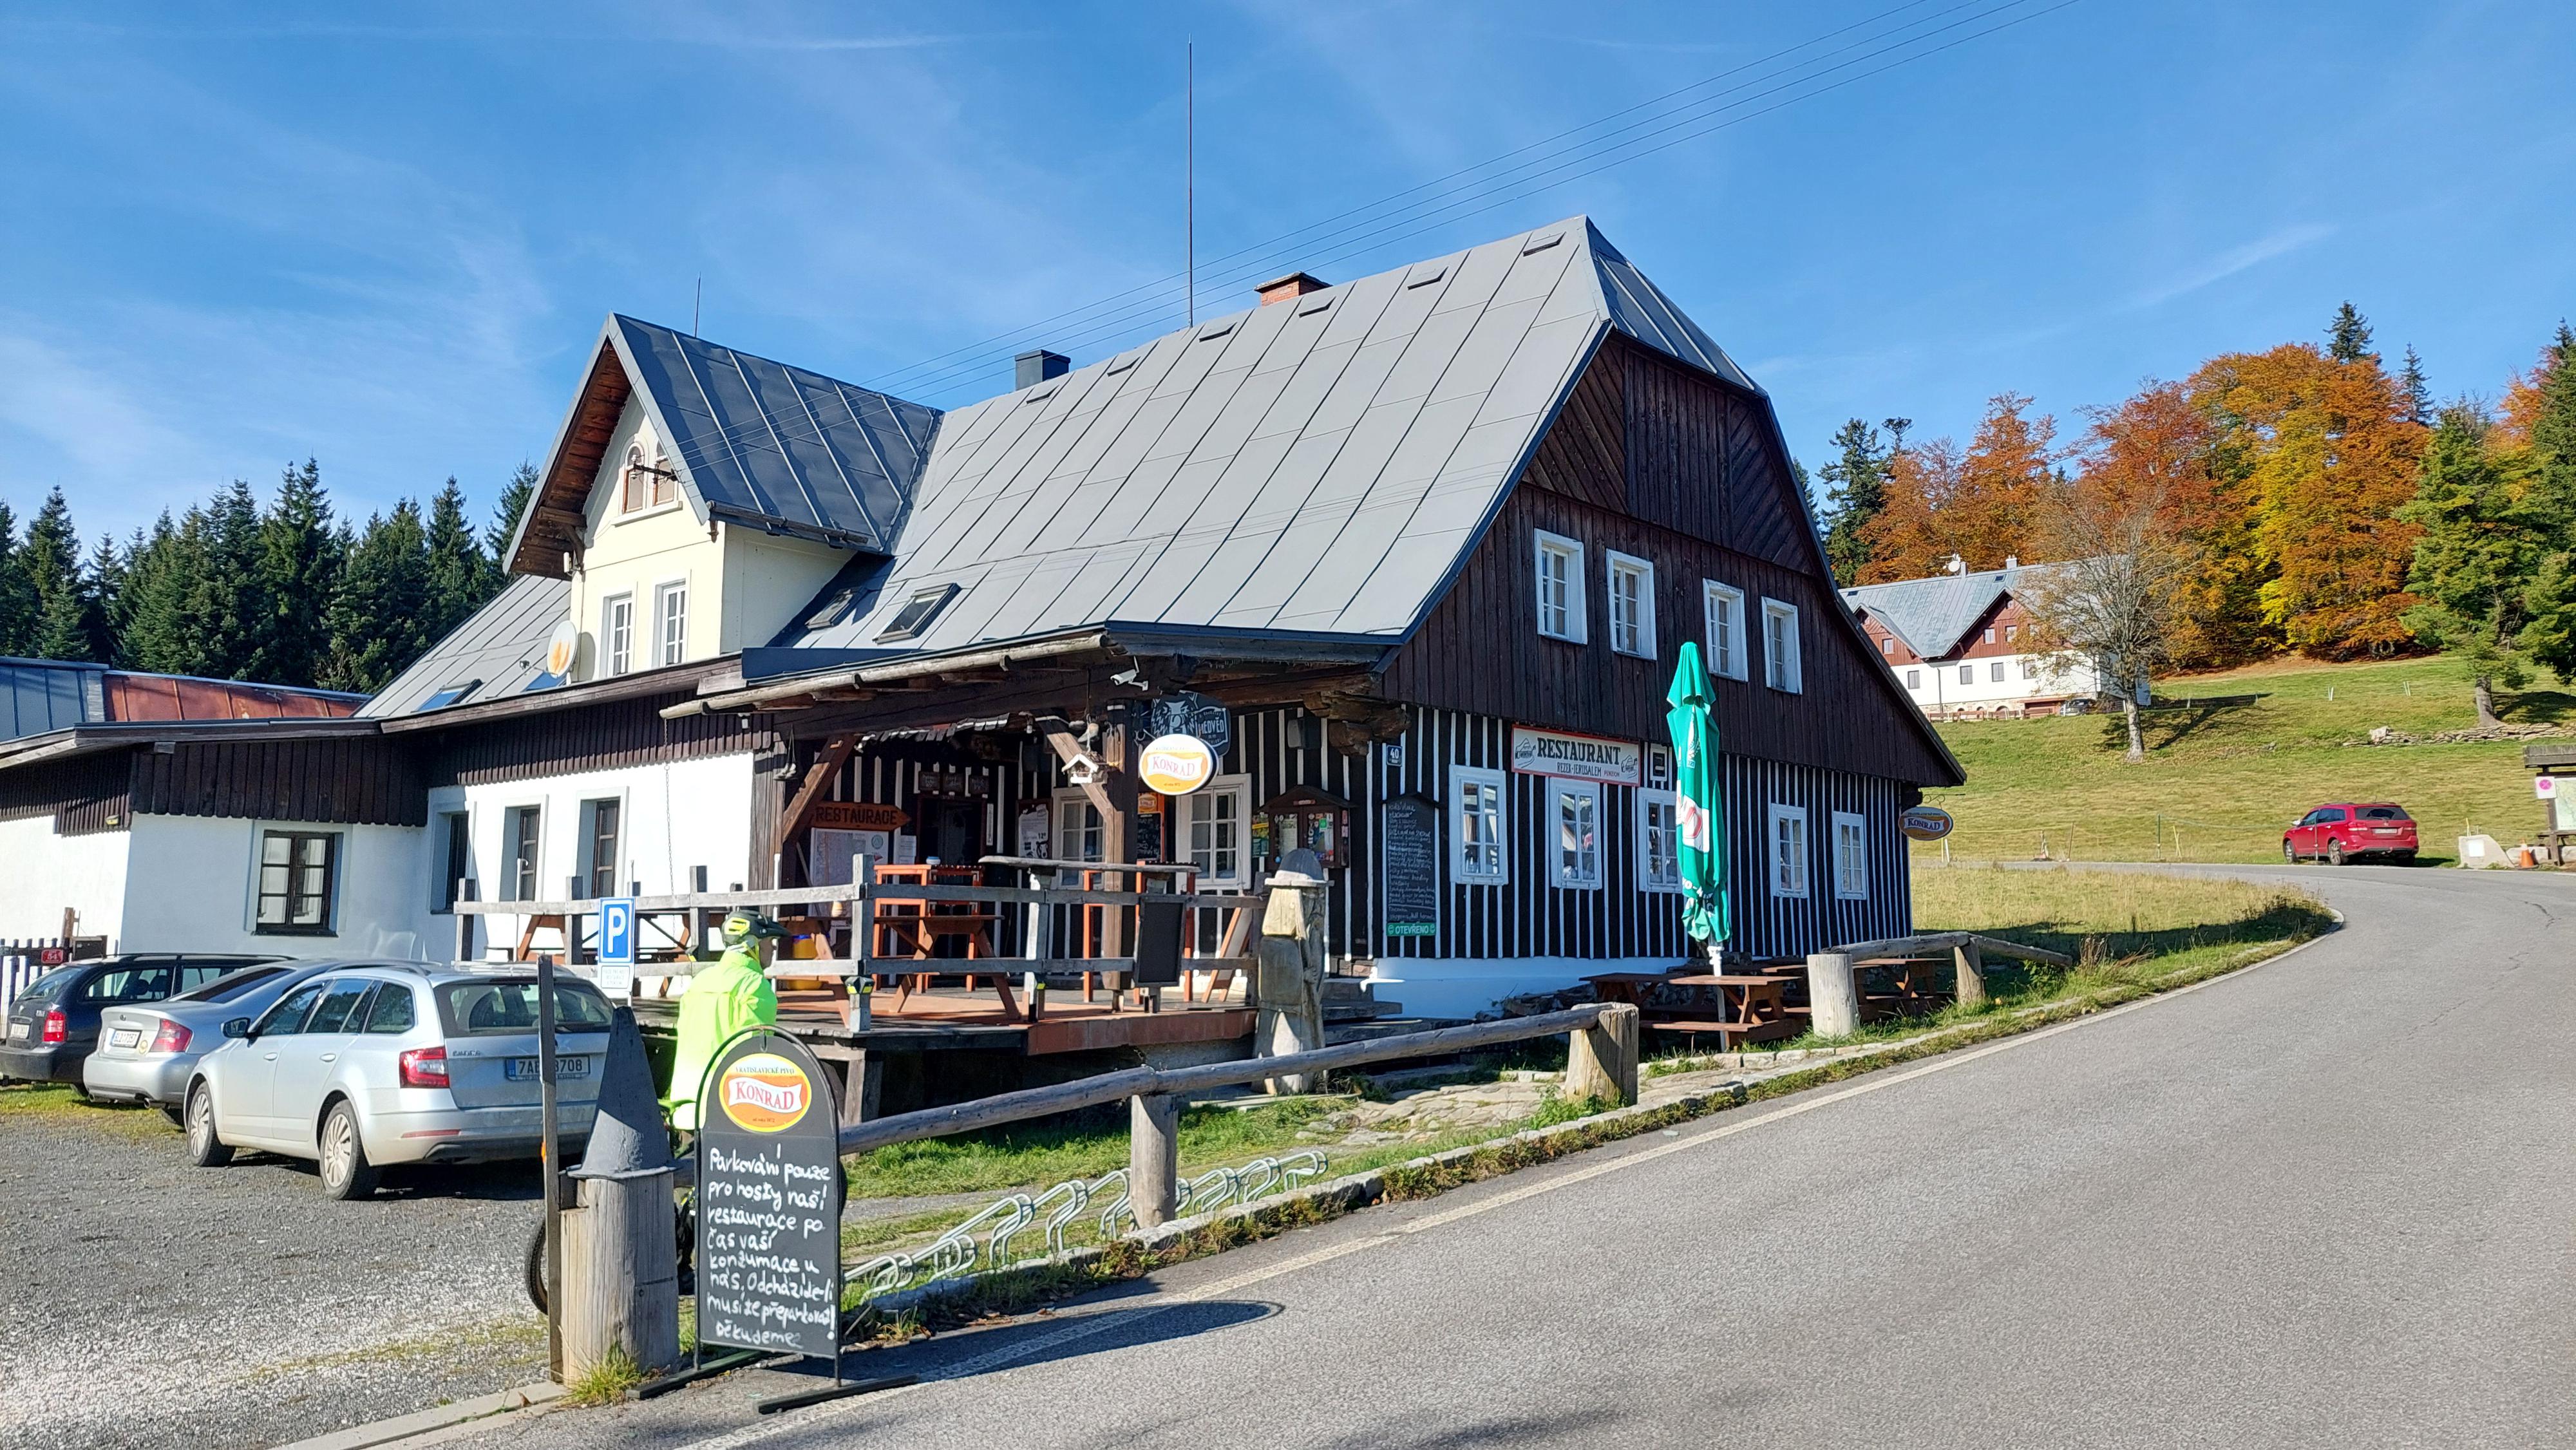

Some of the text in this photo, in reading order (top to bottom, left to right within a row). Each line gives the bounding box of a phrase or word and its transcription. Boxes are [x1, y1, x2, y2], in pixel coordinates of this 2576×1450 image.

[1390, 748, 1399, 758] 40
[1537, 737, 1620, 765] RESTAURANT
[1153, 757, 1195, 776] KONRAD
[1908, 818, 1940, 831] KONRAD
[607, 907, 627, 954] P
[736, 1081, 794, 1110] KONRAD
[710, 1143, 831, 1188] Parkování pouze
[708, 1178, 828, 1212] pro hosty naší
[739, 1229, 778, 1251] vaší
[803, 1218, 824, 1239] po
[804, 1259, 820, 1274] u
[707, 1290, 761, 1317] musíte
